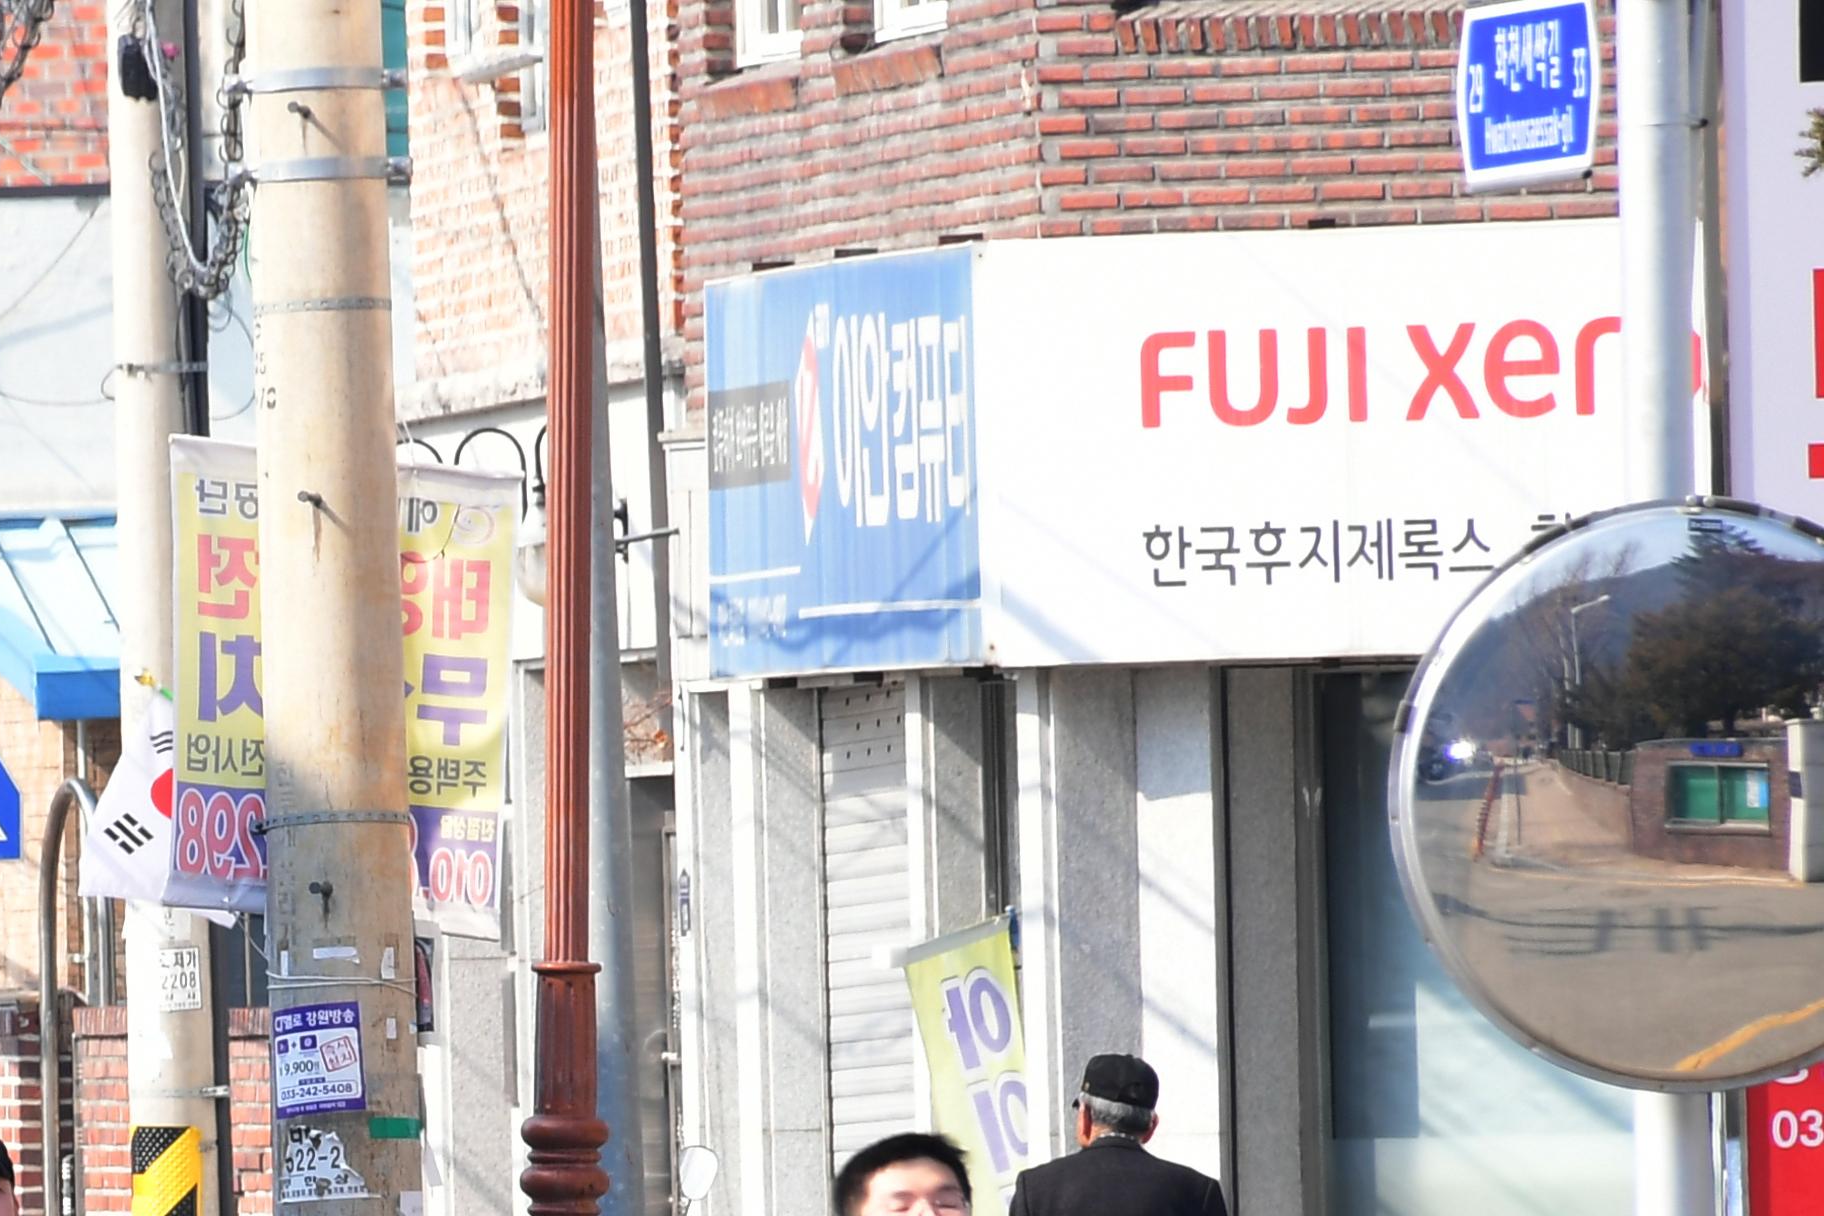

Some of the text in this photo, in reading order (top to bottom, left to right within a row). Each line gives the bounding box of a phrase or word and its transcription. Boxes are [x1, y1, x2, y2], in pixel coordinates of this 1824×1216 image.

[1468, 63, 1484, 114] 29
[1572, 47, 1587, 98] 33
[1140, 315, 1622, 428] FUJI xer
[832, 311, 971, 529] 이안컴퓨터
[1142, 517, 1496, 588] 한국후지제록스
[305, 1008, 356, 1027] 강원방송
[945, 976, 1013, 1071] 10
[281, 1083, 354, 1101] 033-242-5408
